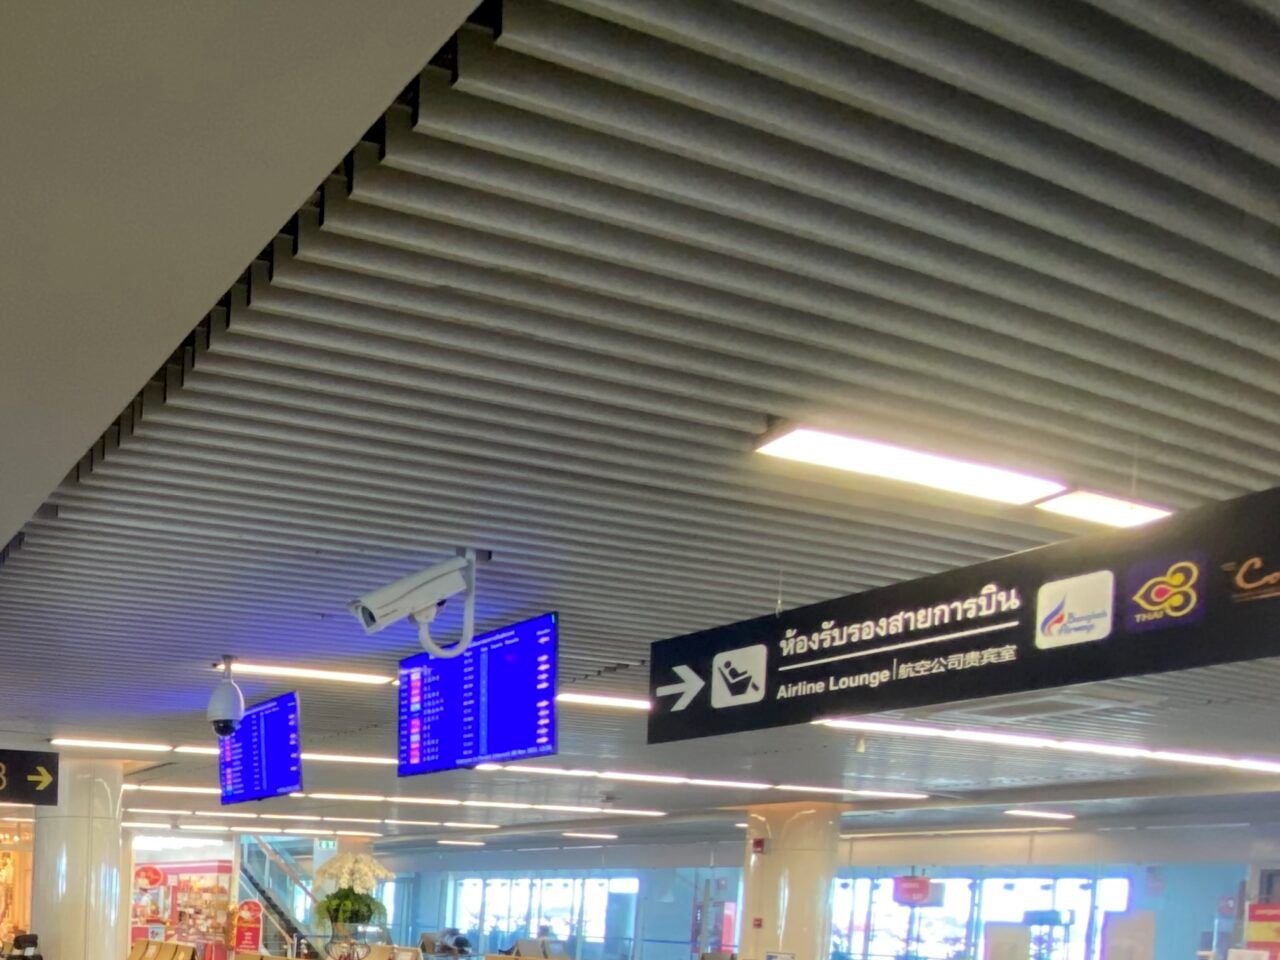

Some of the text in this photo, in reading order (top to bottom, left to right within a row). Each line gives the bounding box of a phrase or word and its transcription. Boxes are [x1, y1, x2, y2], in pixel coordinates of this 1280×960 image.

[779, 583, 1021, 657] ห้องรับรองสายการบิน
[1134, 610, 1165, 623] THAI
[776, 666, 891, 700] Airline Lounge
